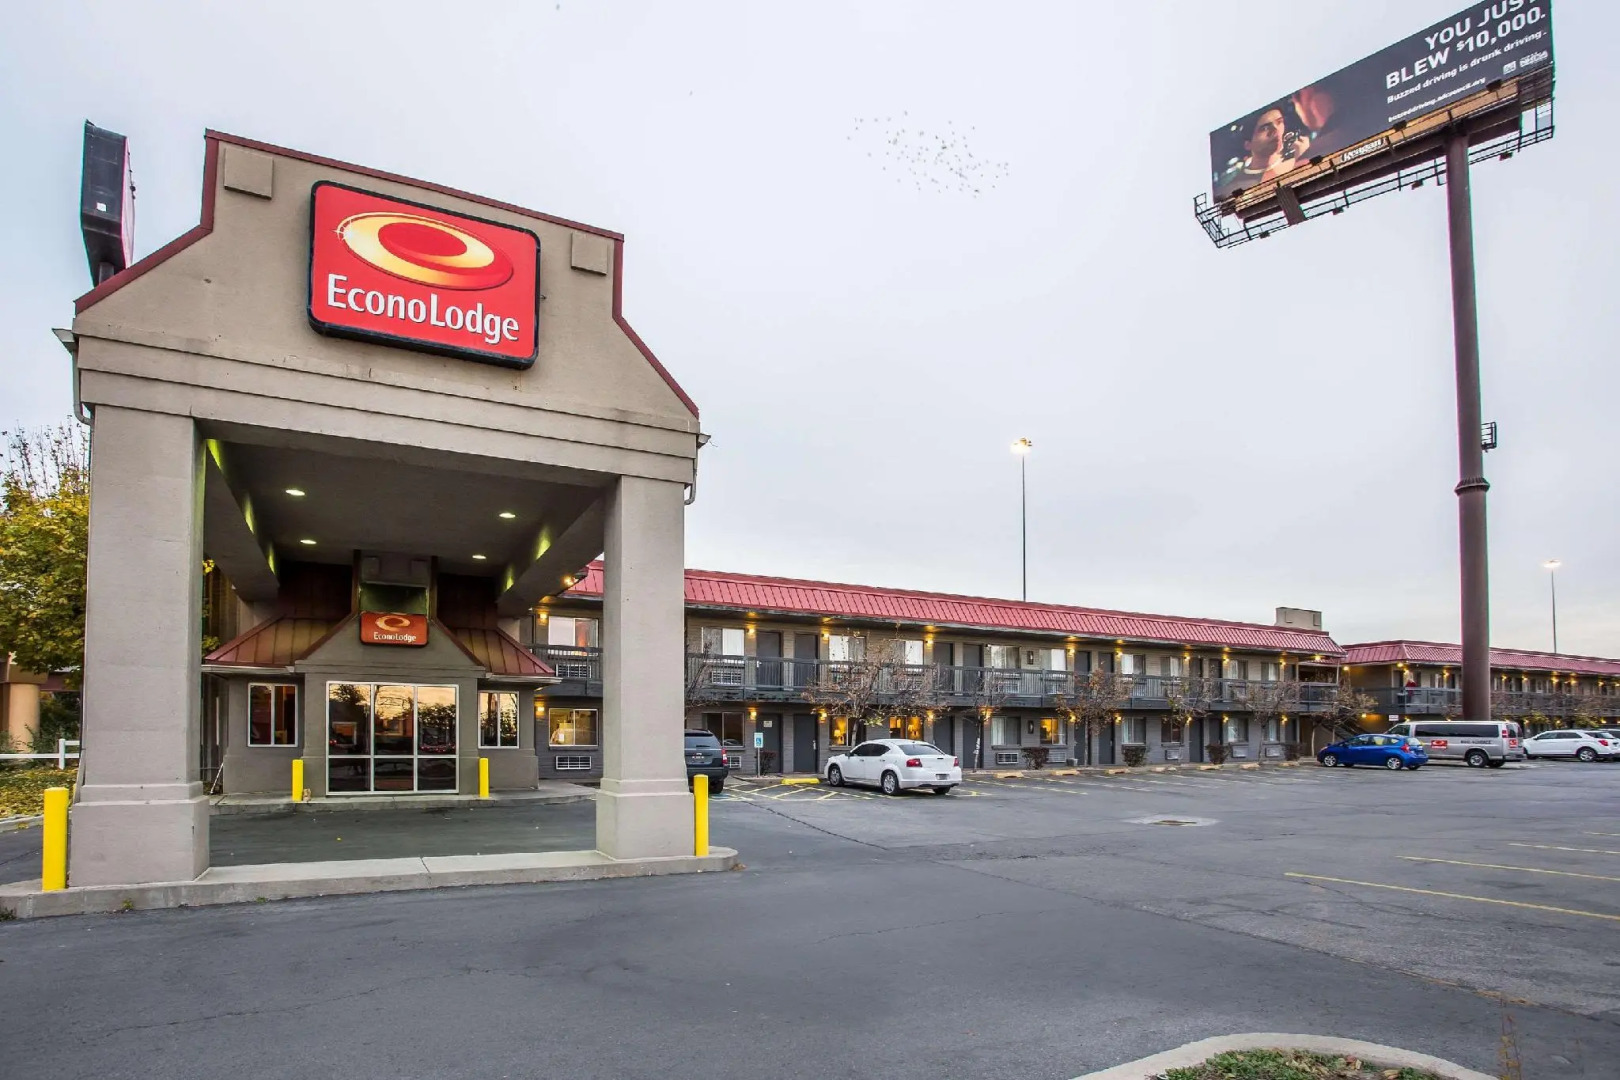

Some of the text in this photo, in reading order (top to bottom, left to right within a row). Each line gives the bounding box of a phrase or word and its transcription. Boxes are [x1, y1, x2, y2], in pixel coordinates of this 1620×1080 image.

[1385, 6, 1546, 89] BLEW $10,000.
[1424, 0, 1535, 51] YOU JUS
[1387, 83, 1421, 104] Buzzed
[1422, 67, 1457, 88] driving
[1458, 64, 1468, 73] is
[1469, 48, 1502, 67] drunk
[1503, 32, 1547, 52] driving.
[327, 273, 519, 344] EconoLodge
[373, 631, 417, 643] EconoLodge
